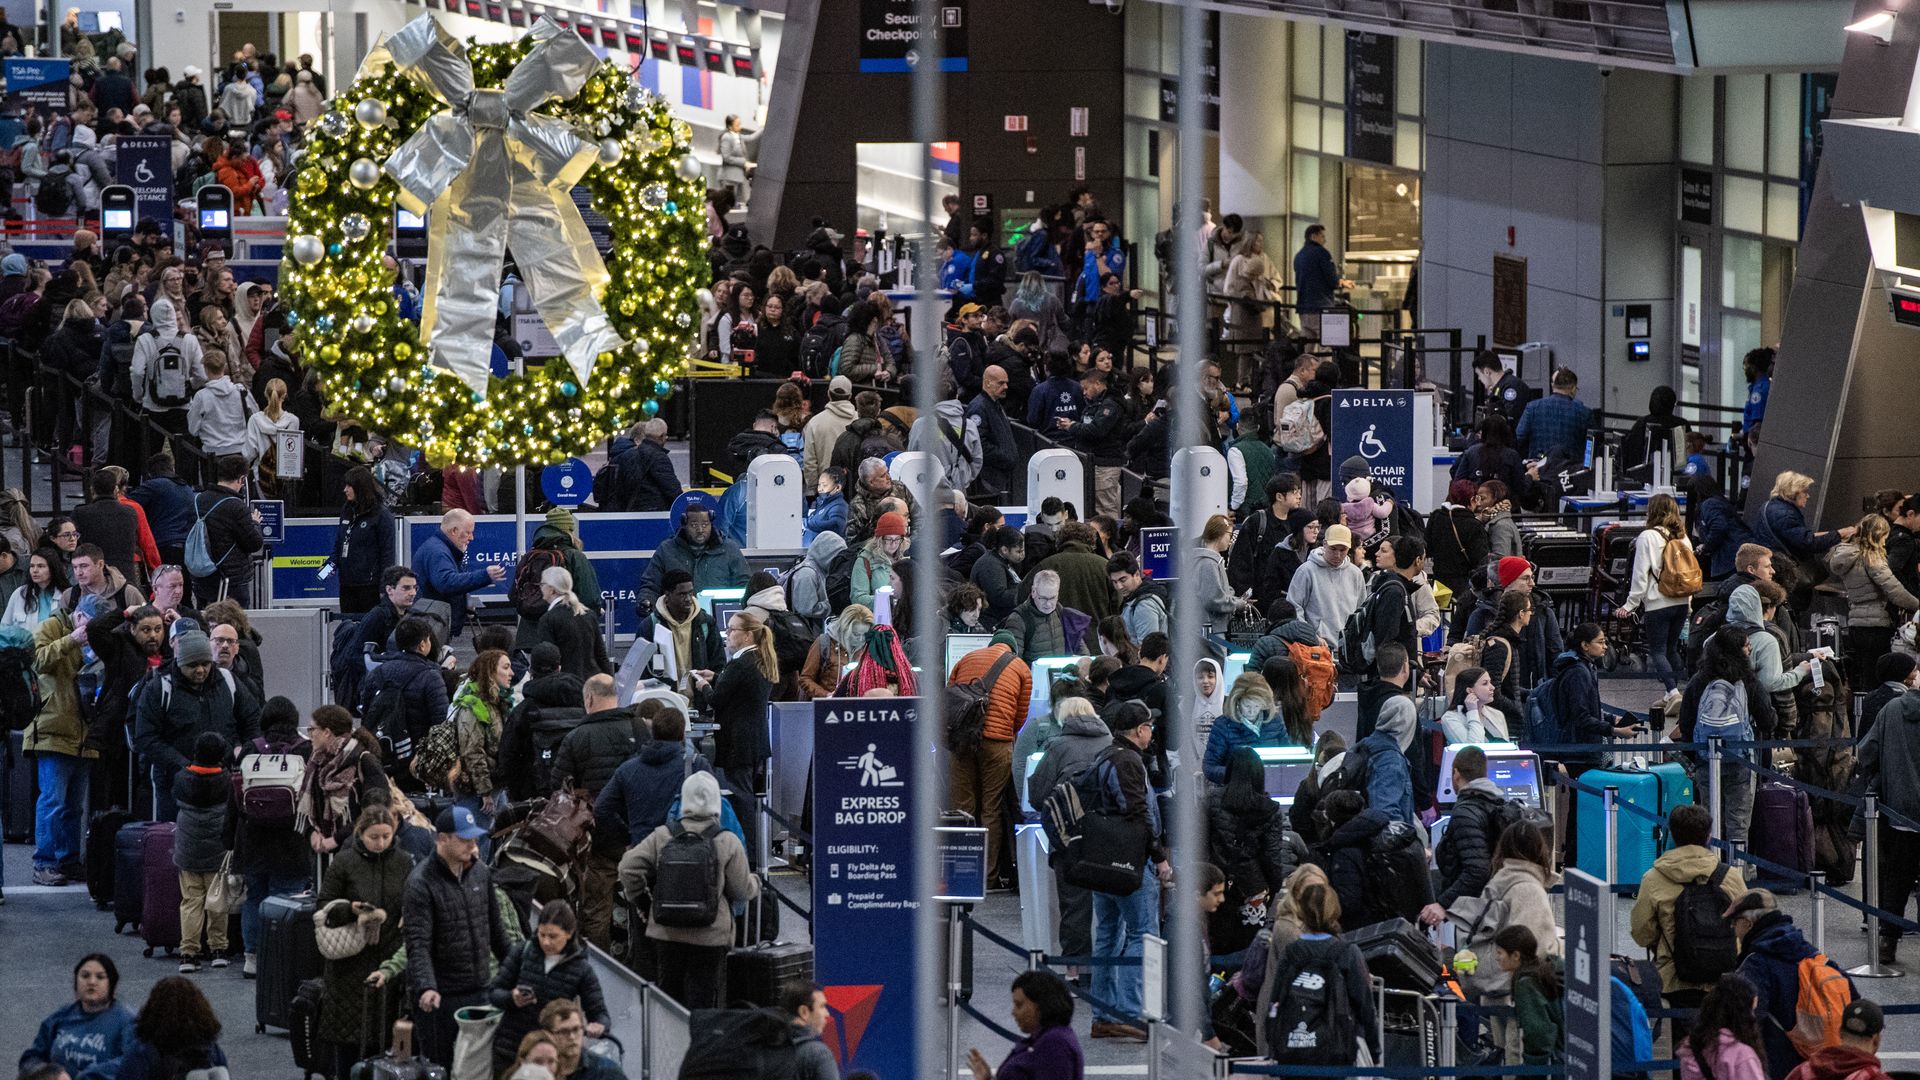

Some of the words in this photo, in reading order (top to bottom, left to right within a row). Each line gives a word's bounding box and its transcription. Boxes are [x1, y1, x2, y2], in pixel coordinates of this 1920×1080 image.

[885, 12, 937, 26] Securiy
[866, 28, 937, 43] Checkpoit
[135, 186, 168, 194] EELCHAIR
[1353, 399, 1394, 407] DELTA
[1369, 466, 1406, 475] LCHAIR
[1371, 476, 1404, 486] TANCE
[1558, 469, 1574, 493] TSA
[1150, 543, 1170, 552] EXIT
[290, 558, 321, 566] Welcome
[600, 590, 636, 600] CLEA
[843, 710, 900, 722] DELTA
[841, 796, 900, 810] EXPRESS
[835, 811, 865, 825] BAG
[867, 811, 907, 825] DROP
[827, 845, 879, 854] ELIGIBILITY:
[848, 863, 858, 872] Fly
[859, 863, 879, 871] Delta
[880, 864, 896, 872] App
[848, 872, 877, 880] Boarding
[878, 871, 898, 880] Pass
[848, 893, 874, 901] Prepaid
[848, 901, 902, 910] Complimentary
